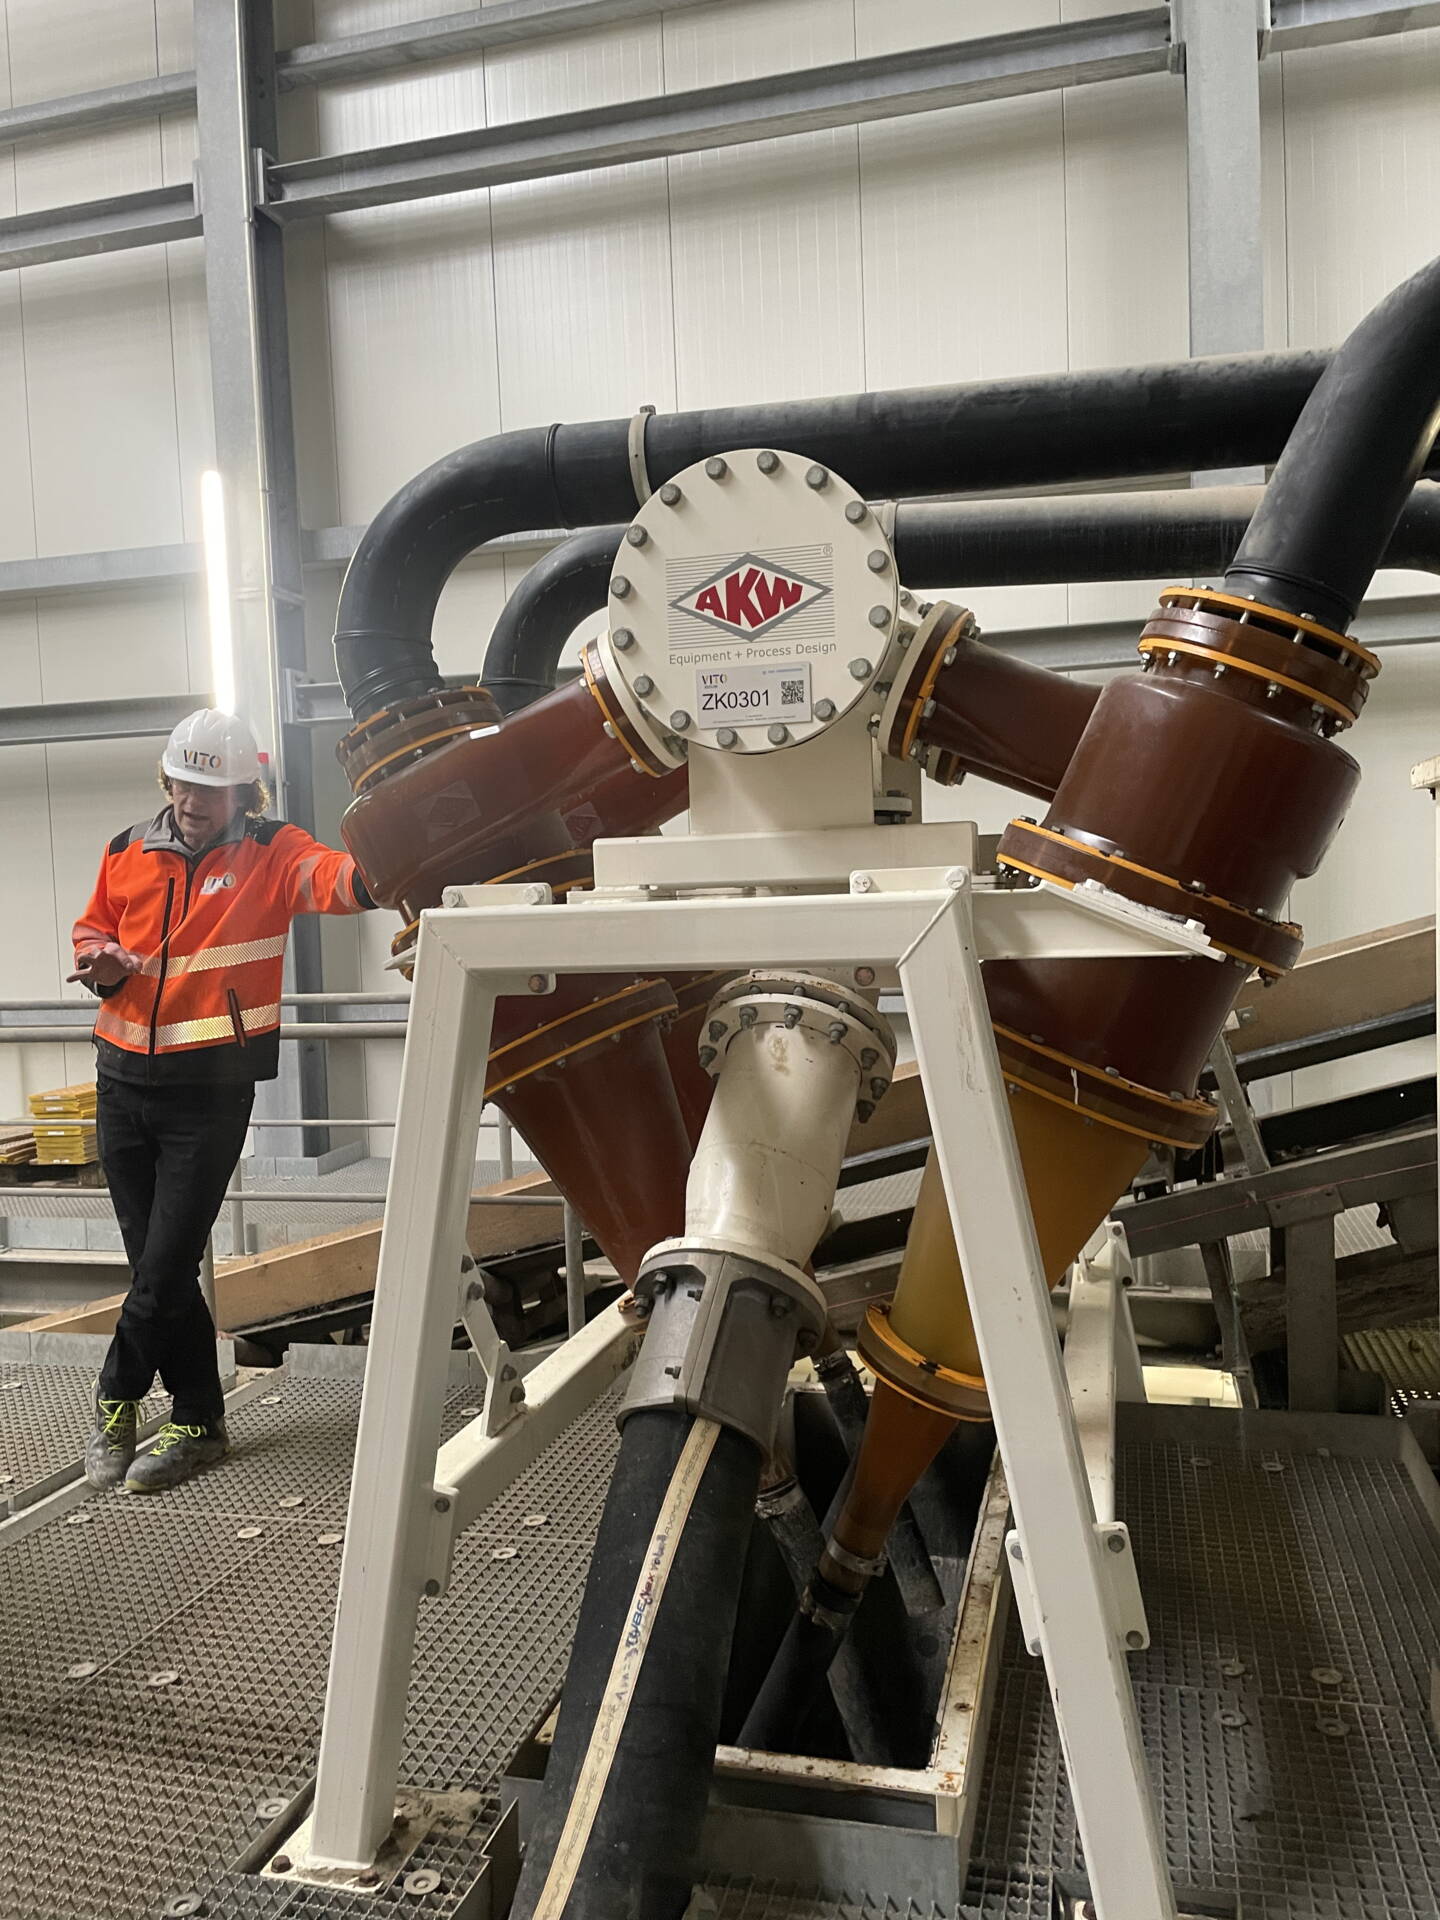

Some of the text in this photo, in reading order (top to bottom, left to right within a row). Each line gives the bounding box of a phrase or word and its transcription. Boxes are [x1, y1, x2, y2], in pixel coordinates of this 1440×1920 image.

[694, 567, 804, 629] AKW
[669, 651, 731, 666] Equipment
[746, 646, 791, 659] Process
[795, 642, 837, 656] Design
[701, 673, 728, 685] VITO
[702, 689, 769, 711] ZK0301
[183, 748, 222, 769] VITO
